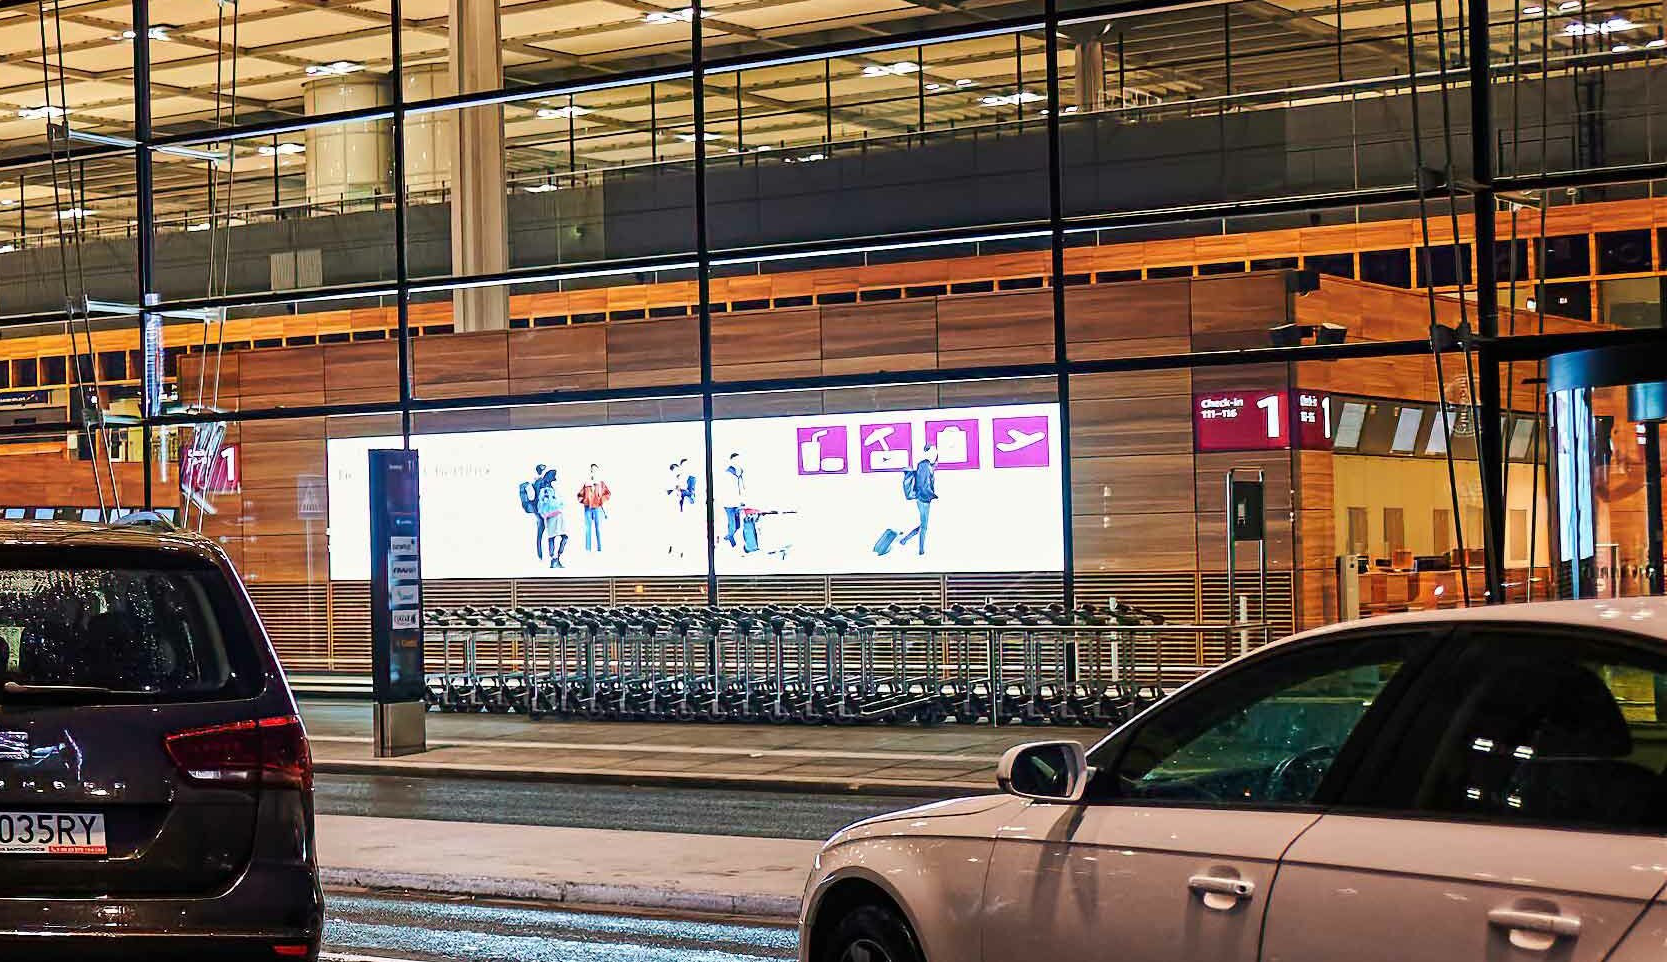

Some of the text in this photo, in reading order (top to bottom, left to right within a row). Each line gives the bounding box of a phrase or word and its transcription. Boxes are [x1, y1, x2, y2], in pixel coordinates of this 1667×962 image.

[1200, 397, 1244, 408] Check-in
[1256, 395, 1280, 438] 1
[220, 446, 235, 481] 1
